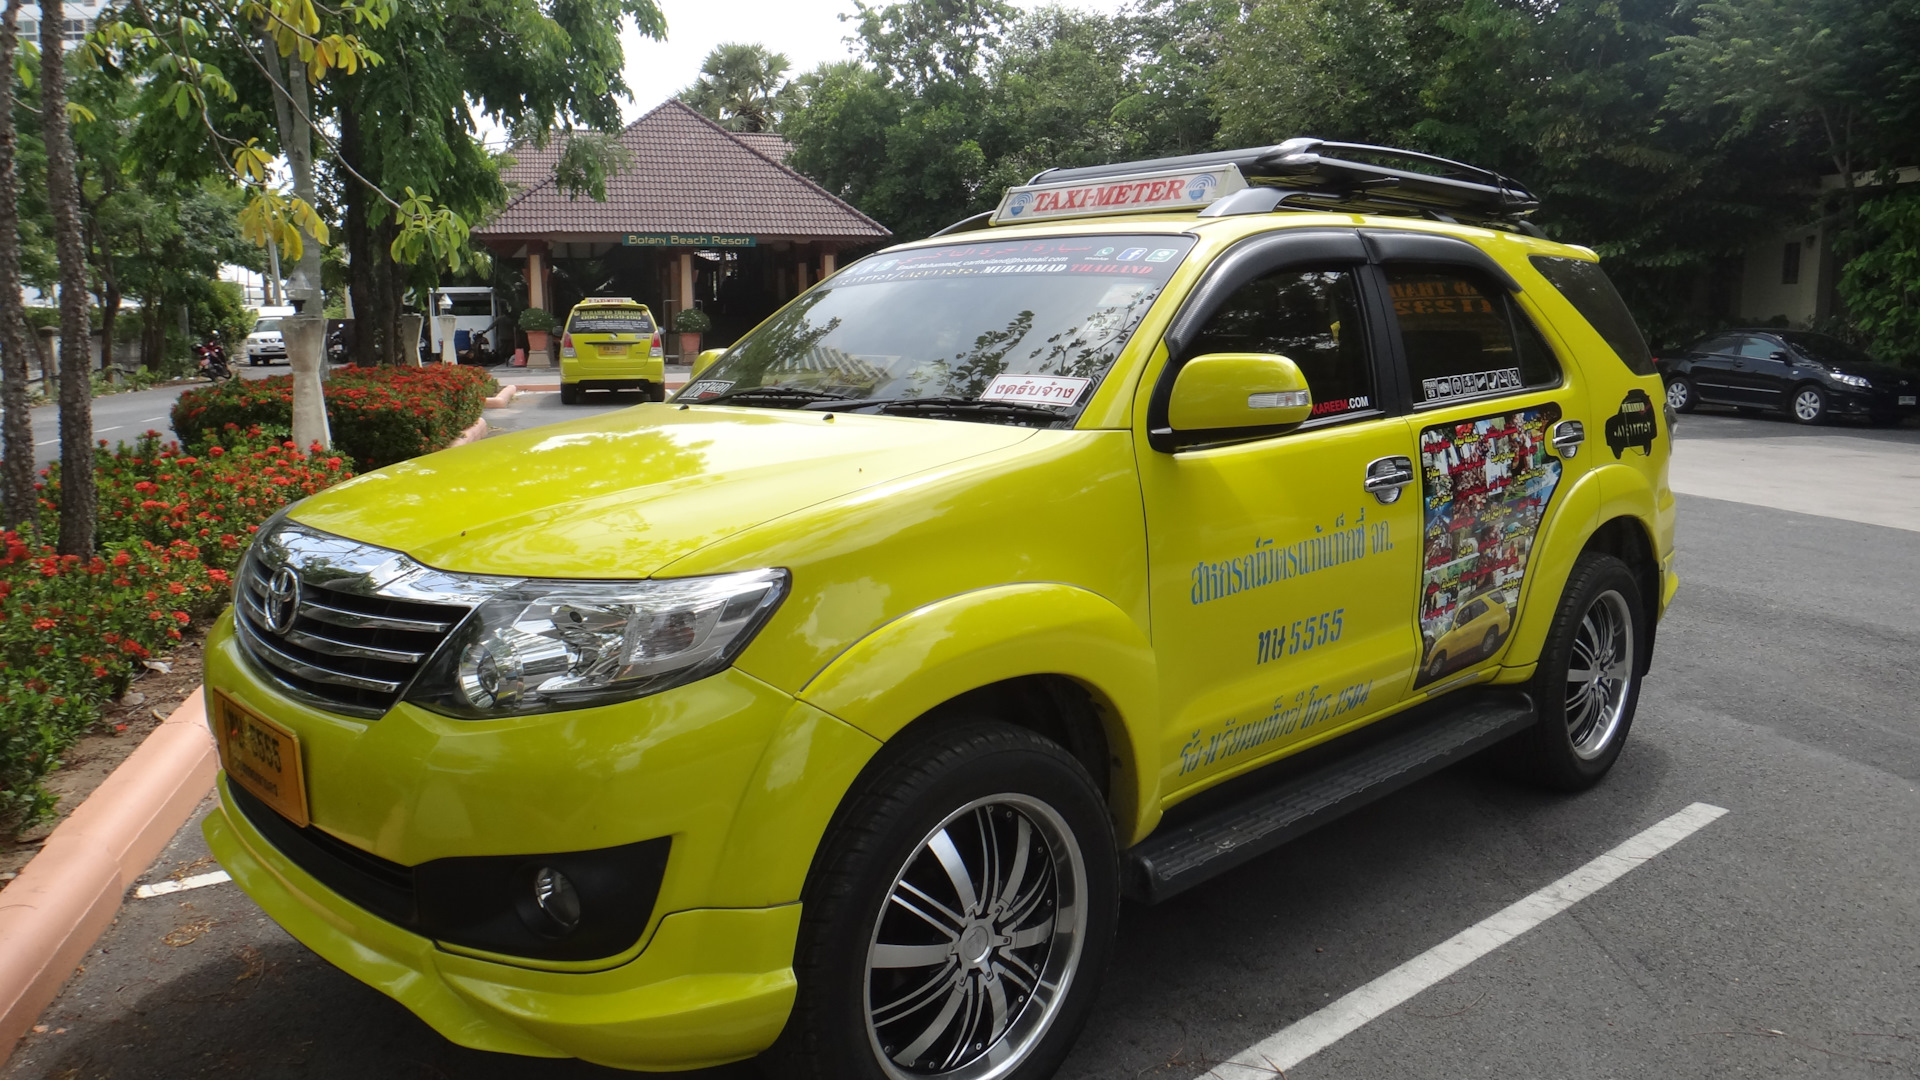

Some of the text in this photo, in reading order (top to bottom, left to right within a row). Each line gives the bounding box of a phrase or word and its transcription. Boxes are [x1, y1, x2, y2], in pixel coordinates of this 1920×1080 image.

[1033, 179, 1186, 212] TAXI-METER
[628, 235, 750, 246] Botany Beach Resort
[979, 264, 1154, 275] MUHAMMAD THAILAND
[995, 380, 1075, 399] งดรับจ้าง
[1289, 608, 1345, 655] 5555
